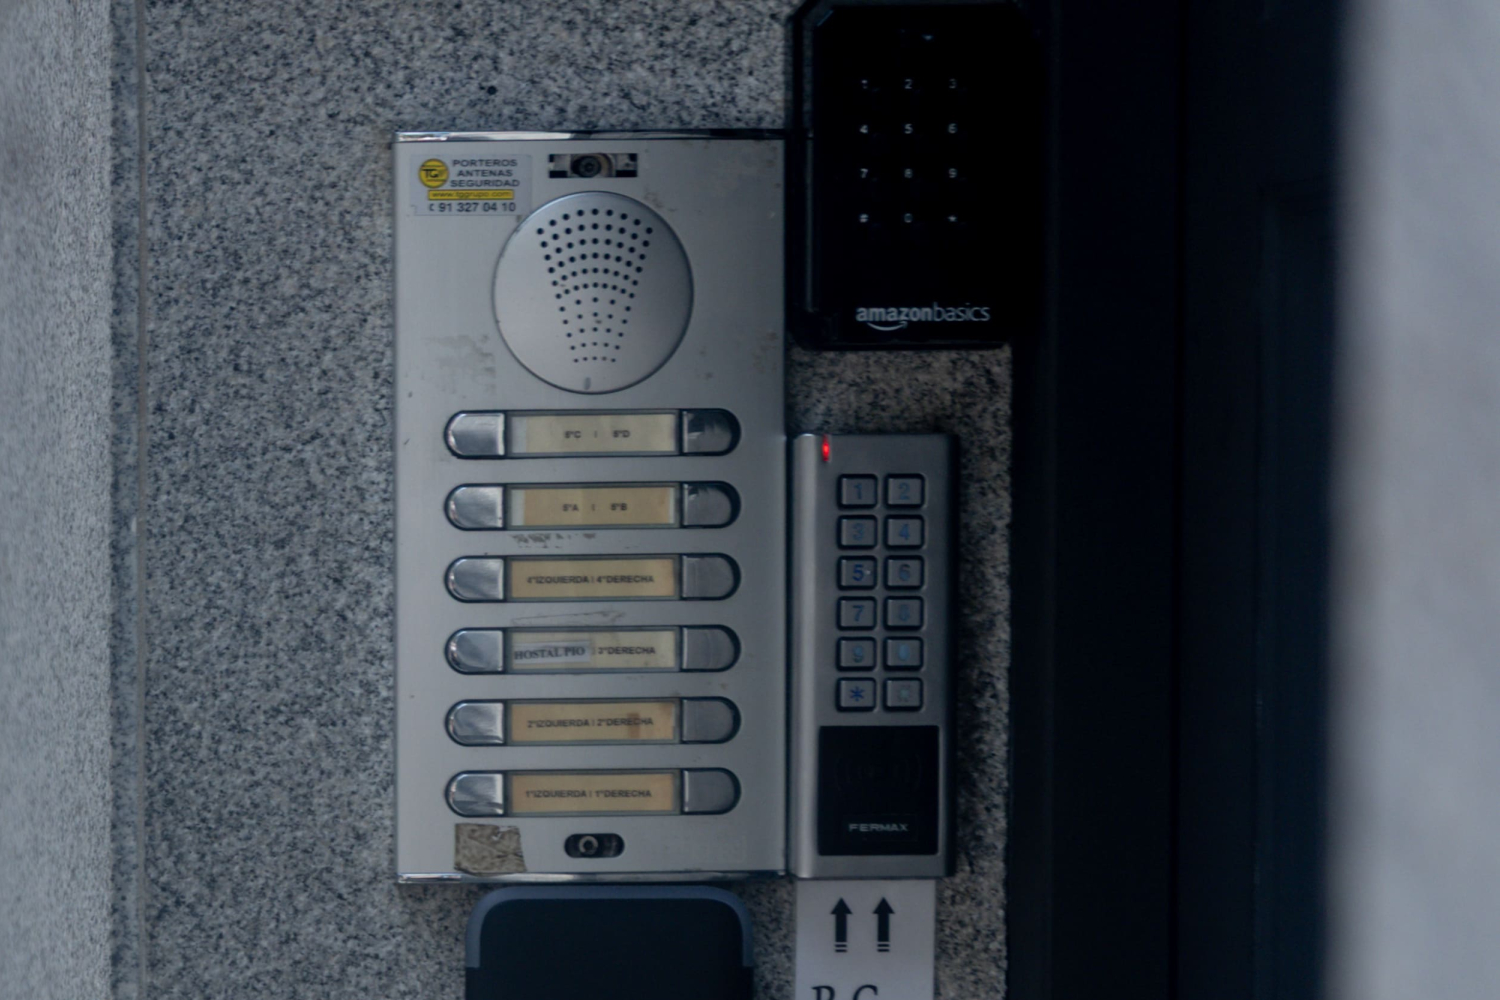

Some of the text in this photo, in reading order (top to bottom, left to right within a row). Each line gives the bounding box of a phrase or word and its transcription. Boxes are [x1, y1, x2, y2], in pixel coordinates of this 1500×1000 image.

[903, 77, 914, 90] 2
[947, 77, 958, 90] 3
[903, 122, 914, 135] 5
[452, 159, 518, 168] PORTEROS
[457, 169, 513, 177] ANTENAS
[858, 167, 869, 179] 7
[450, 179, 520, 188] SEGURIDAD
[438, 202, 516, 212] 91 327 04 10
[855, 301, 991, 323] amazonbasics
[853, 482, 911, 501] 1 2
[852, 523, 911, 541] 3 4
[852, 564, 911, 582] 5 6
[851, 605, 865, 622] 7
[514, 648, 563, 660] HOSTAL
[848, 823, 909, 833] FERMAX
